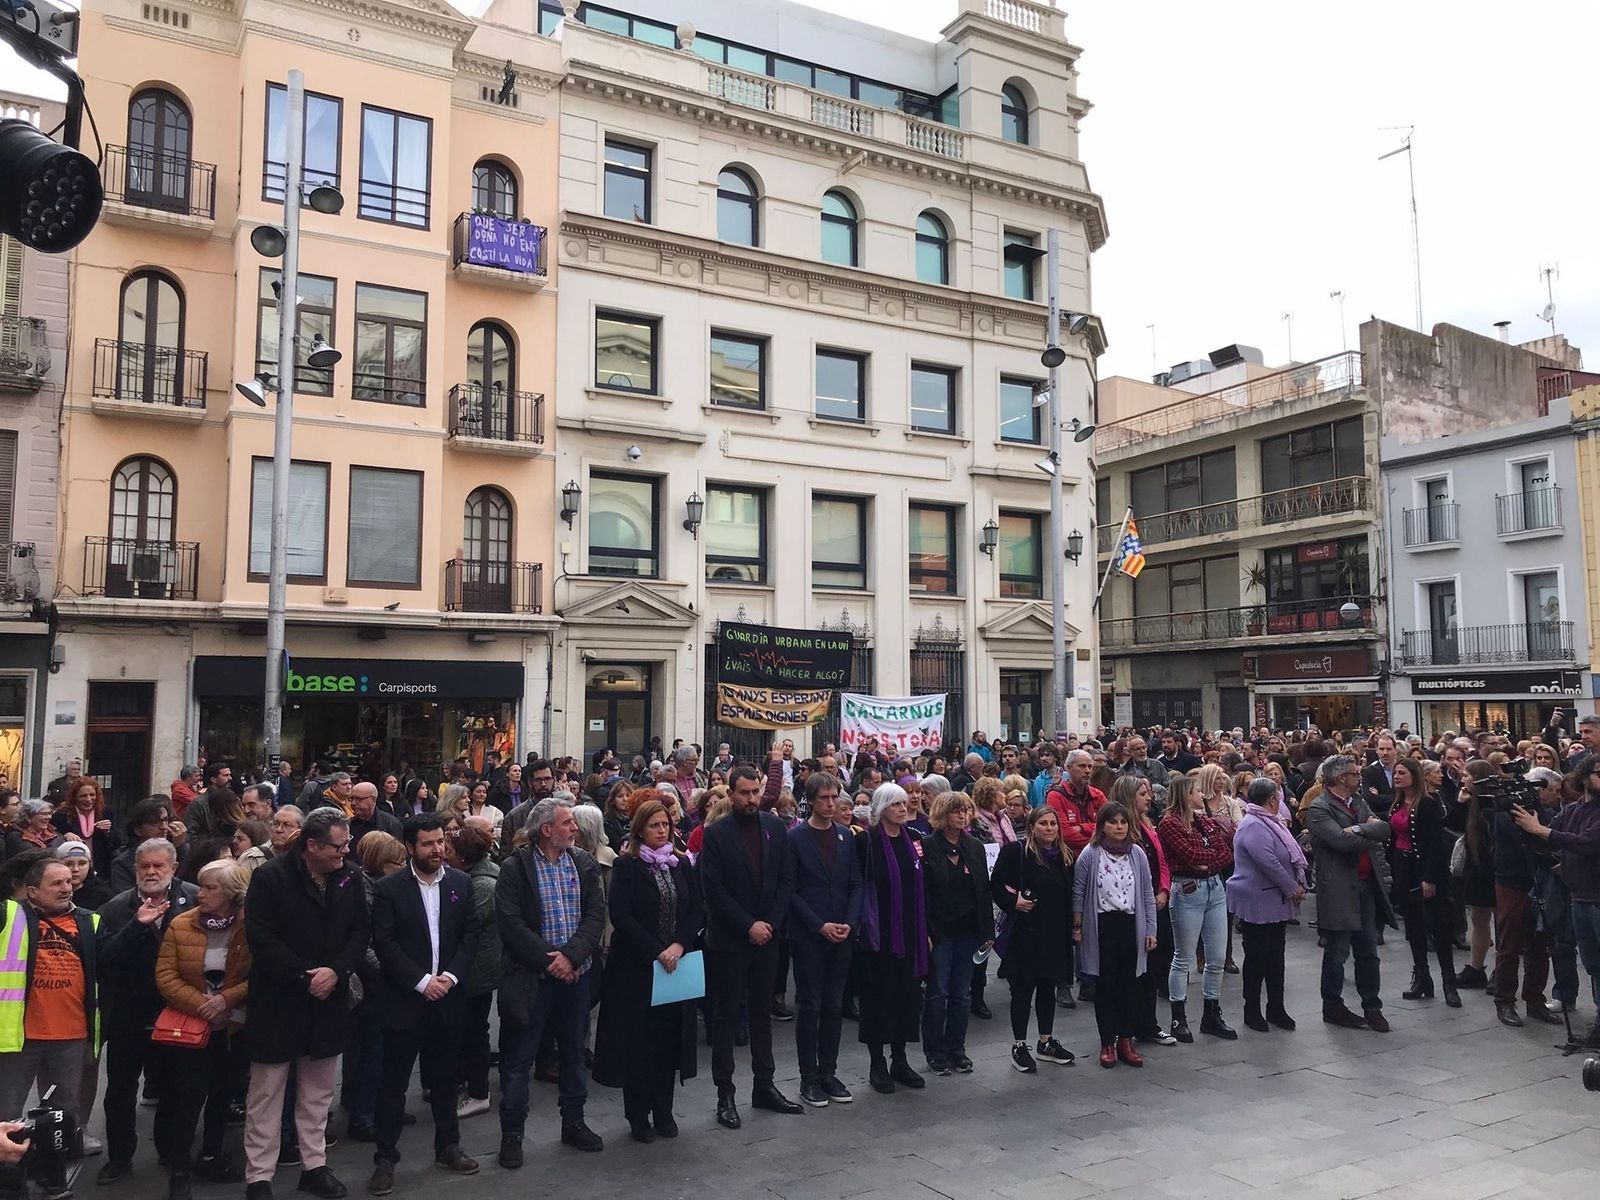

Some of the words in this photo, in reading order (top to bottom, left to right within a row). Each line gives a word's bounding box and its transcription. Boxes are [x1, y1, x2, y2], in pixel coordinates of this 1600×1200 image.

[500, 252, 510, 263] LA
[775, 636, 812, 649] URBANA
[815, 639, 826, 650] EN
[828, 641, 837, 650] LA
[765, 666, 772, 676] A
[779, 667, 810, 680] HACER
[815, 669, 845, 683] ALGO?
[378, 682, 437, 694] Carpisports
[771, 689, 831, 704] ESPERANT
[721, 703, 763, 721] ESPAIS
[32, 978, 72, 990] ADALONA
